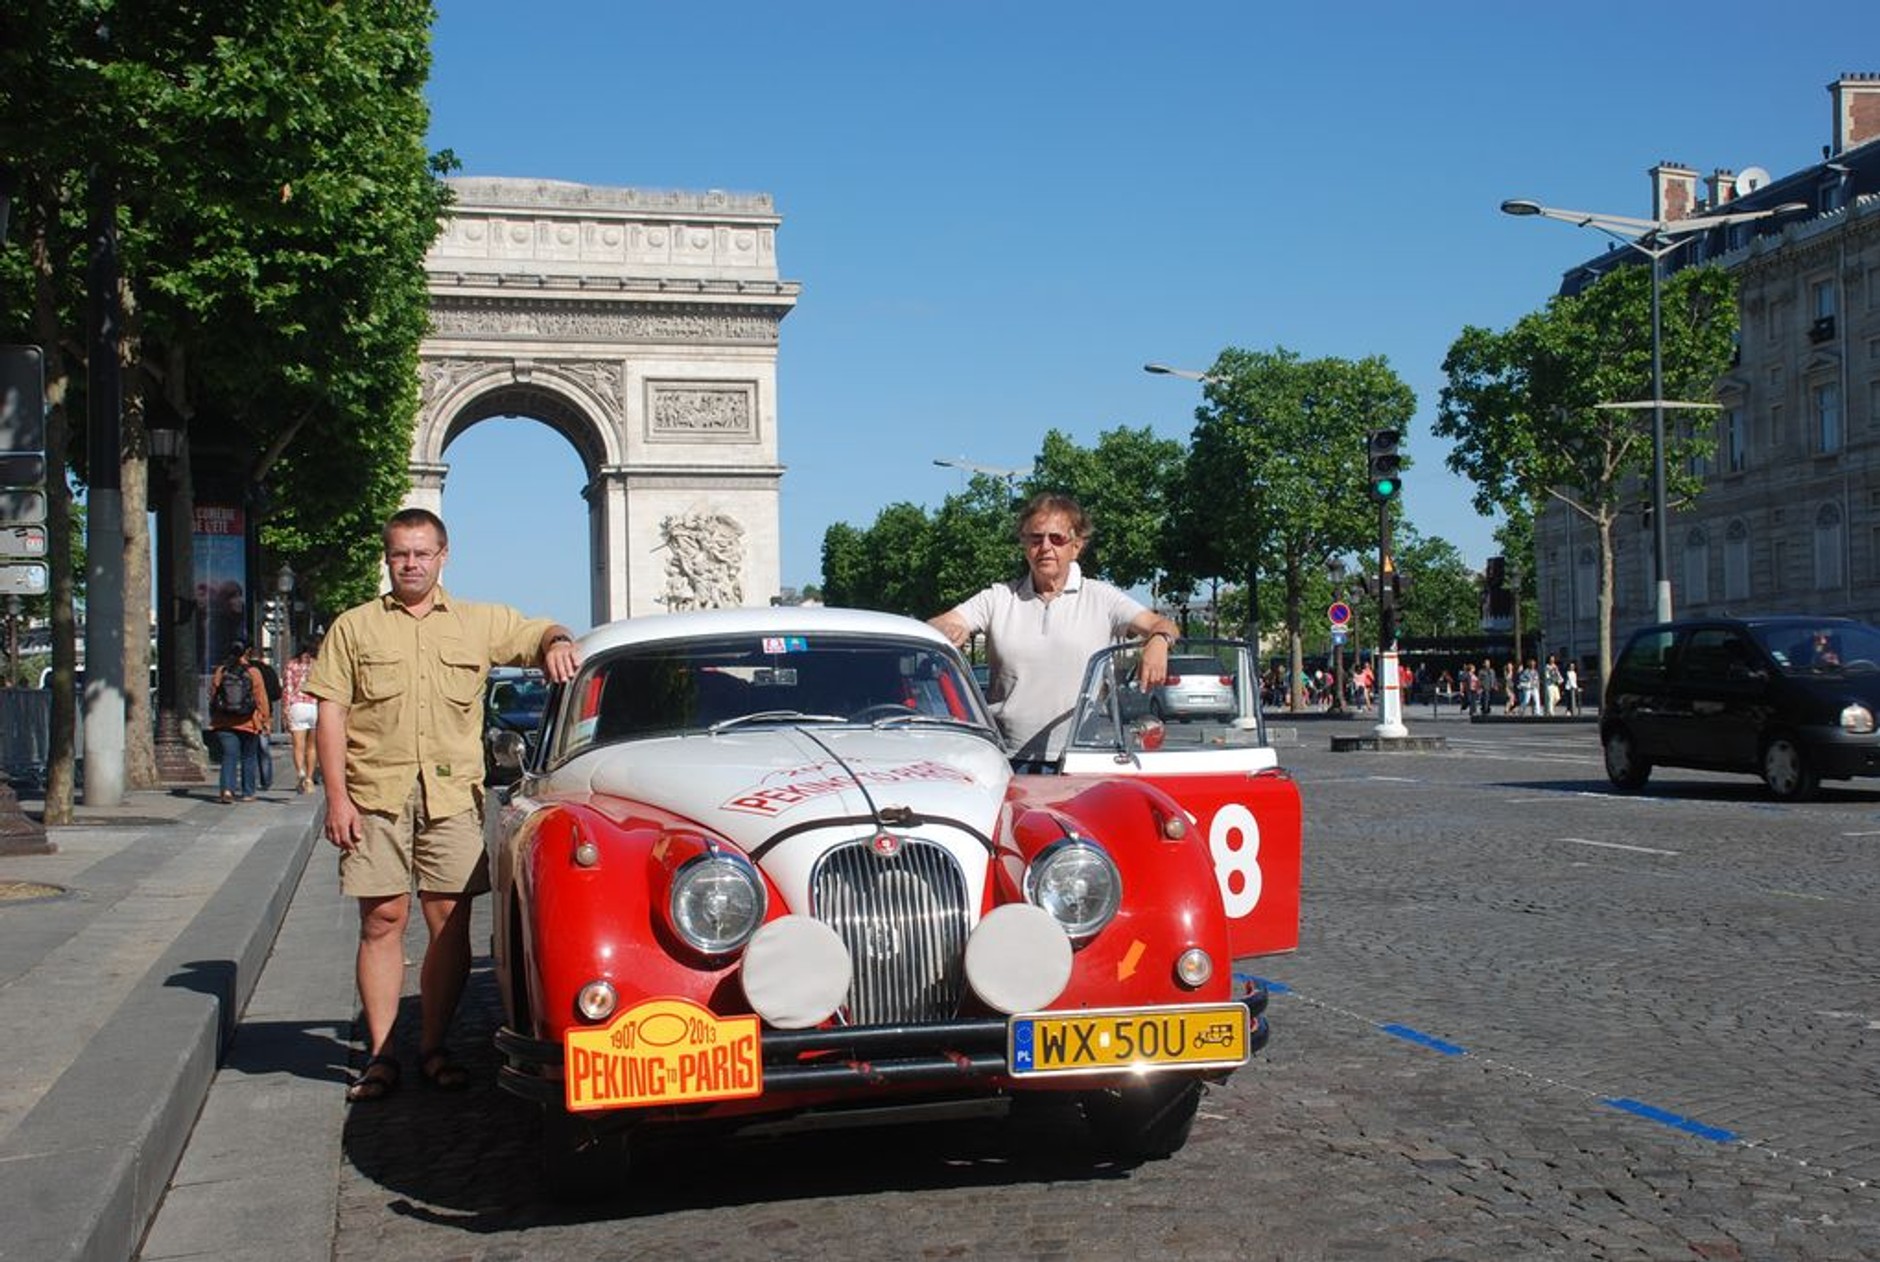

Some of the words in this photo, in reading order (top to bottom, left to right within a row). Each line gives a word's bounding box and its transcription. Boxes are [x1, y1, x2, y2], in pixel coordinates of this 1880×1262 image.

[1184, 803, 1263, 919] 8
[610, 1021, 637, 1049] 1907
[689, 1017, 716, 1045] 2013
[1042, 1023, 1097, 1064] WX
[1114, 1018, 1187, 1060] 50U
[573, 1046, 666, 1101] PEKING
[667, 1068, 678, 1084] TO
[678, 1034, 754, 1093] PARIS
[1017, 1050, 1032, 1063] PL
